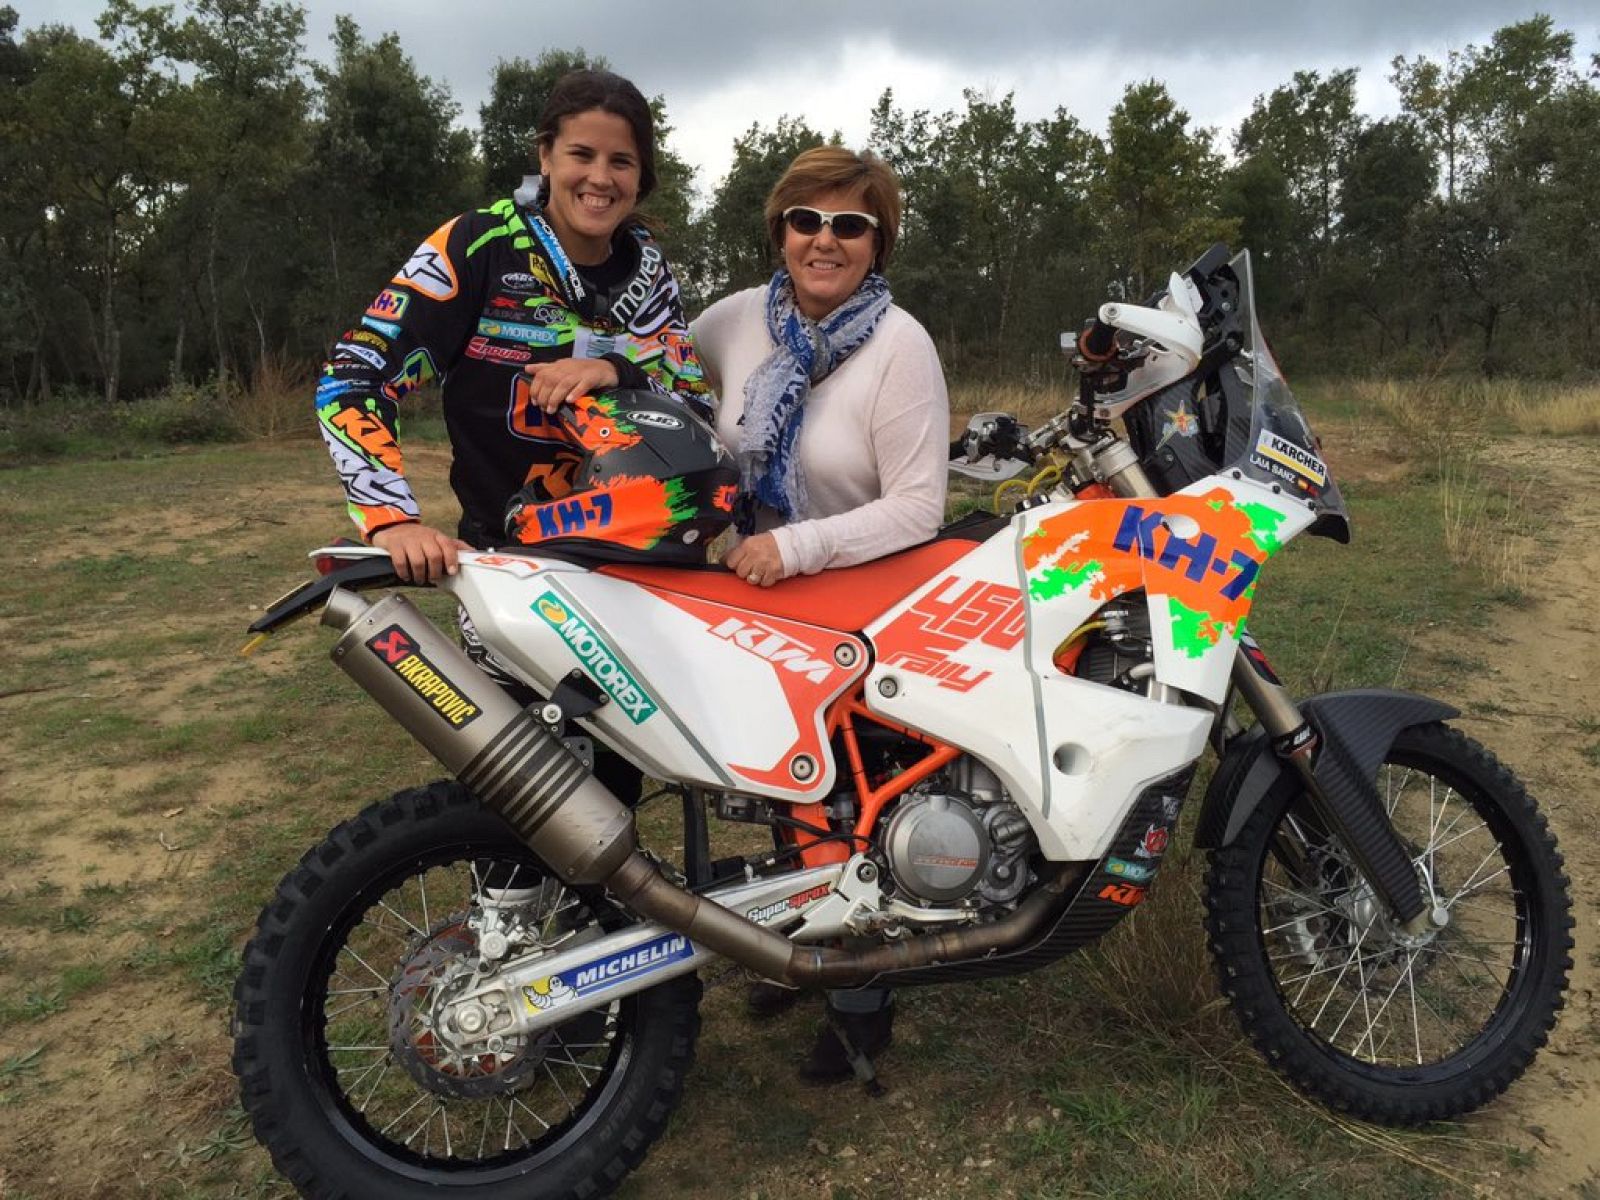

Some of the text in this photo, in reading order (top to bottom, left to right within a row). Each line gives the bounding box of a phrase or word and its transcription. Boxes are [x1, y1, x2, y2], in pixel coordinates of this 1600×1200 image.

[611, 246, 662, 324] moveo
[502, 325, 556, 343] MOTOREX
[536, 493, 613, 538] KH-7
[1112, 505, 1260, 602] KH-7
[558, 617, 652, 719] MOTOREX
[706, 617, 834, 685] KTM
[883, 650, 993, 693] rally
[575, 935, 687, 987] MICHELIN
